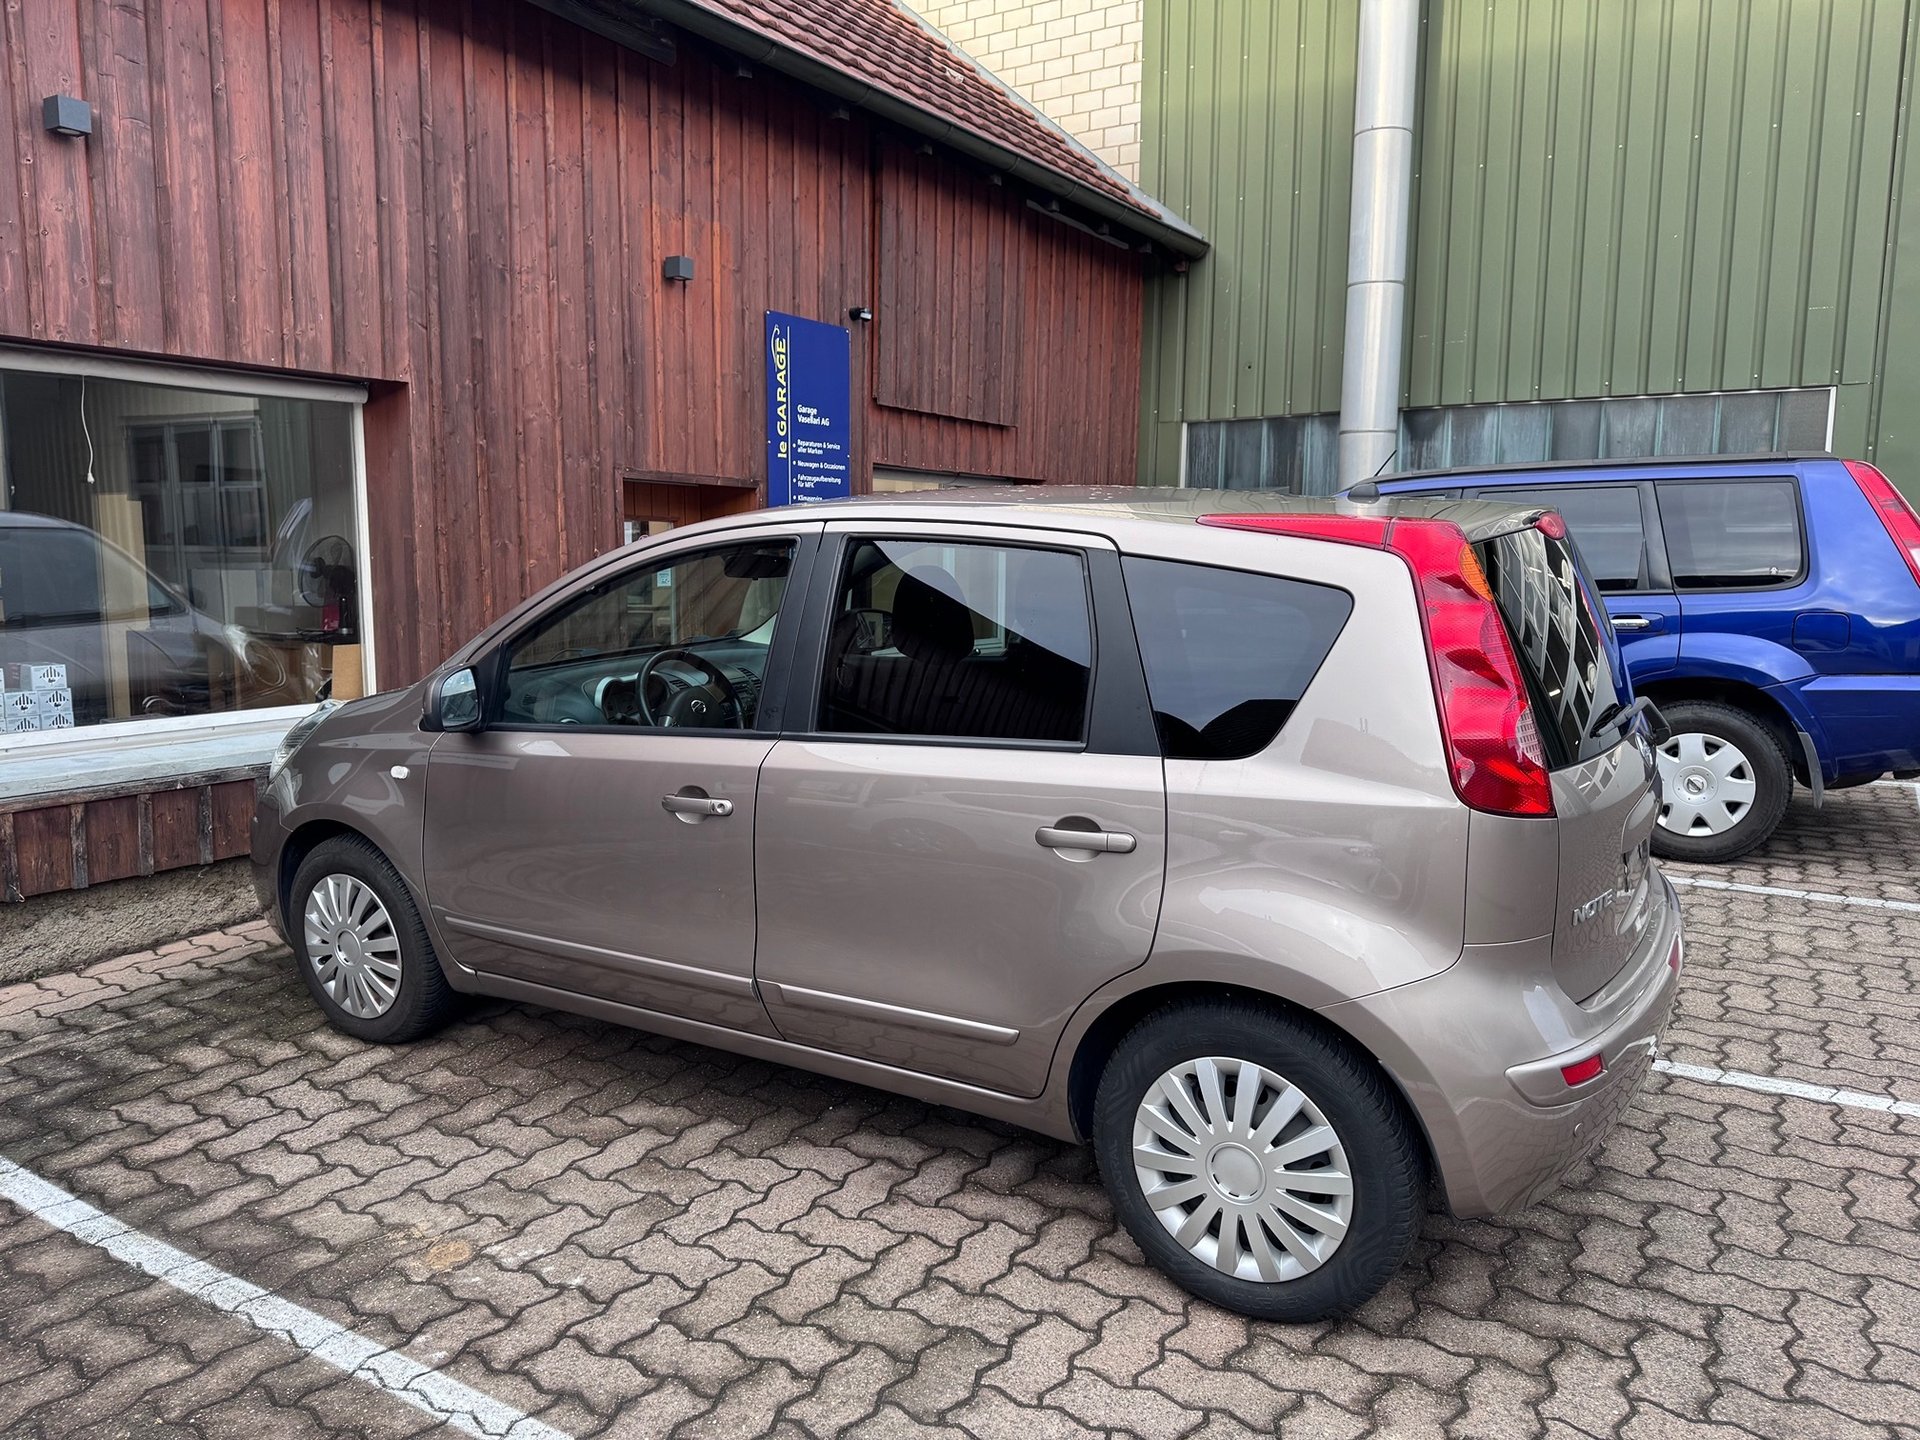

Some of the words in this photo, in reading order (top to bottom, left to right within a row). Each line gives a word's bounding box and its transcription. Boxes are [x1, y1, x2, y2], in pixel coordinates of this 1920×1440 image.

[777, 338, 787, 436] GARAGE
[797, 404, 818, 416] Garage
[797, 414, 820, 425] Vasellari
[821, 417, 830, 426] AG
[778, 441, 787, 458] le
[797, 439, 822, 448] Reparaturen
[807, 447, 823, 455] Marken
[797, 460, 819, 469] Neuwagen
[824, 462, 846, 470] Occasionen
[798, 474, 841, 485] Fahrzeugaufbereitung
[1572, 888, 1613, 926] NOTE
